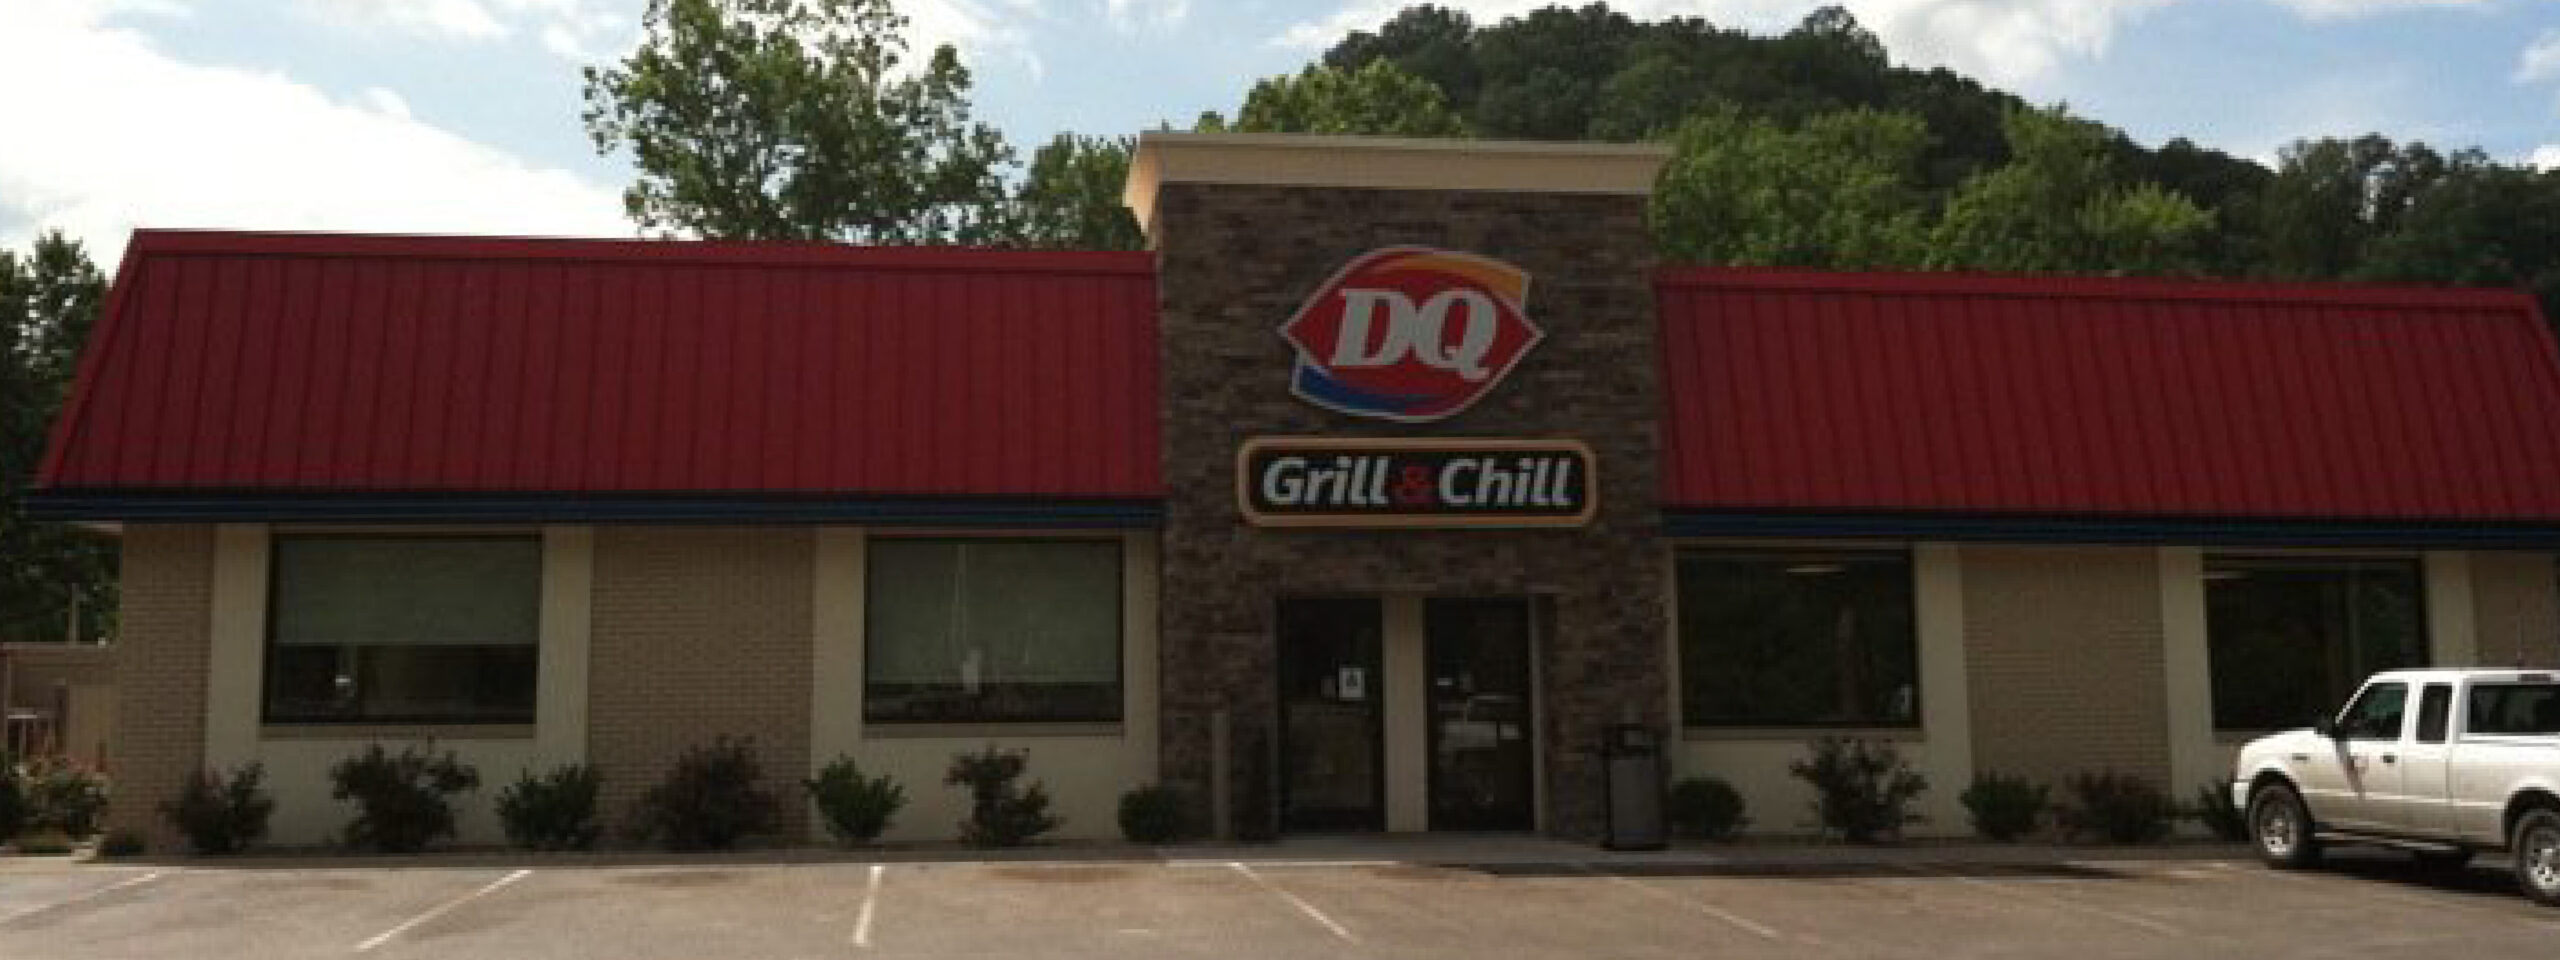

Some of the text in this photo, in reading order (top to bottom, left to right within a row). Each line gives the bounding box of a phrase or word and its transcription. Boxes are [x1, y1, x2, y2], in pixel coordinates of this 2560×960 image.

[1331, 287, 1498, 380] DQ
[1262, 456, 1573, 507] Grill & Chill
